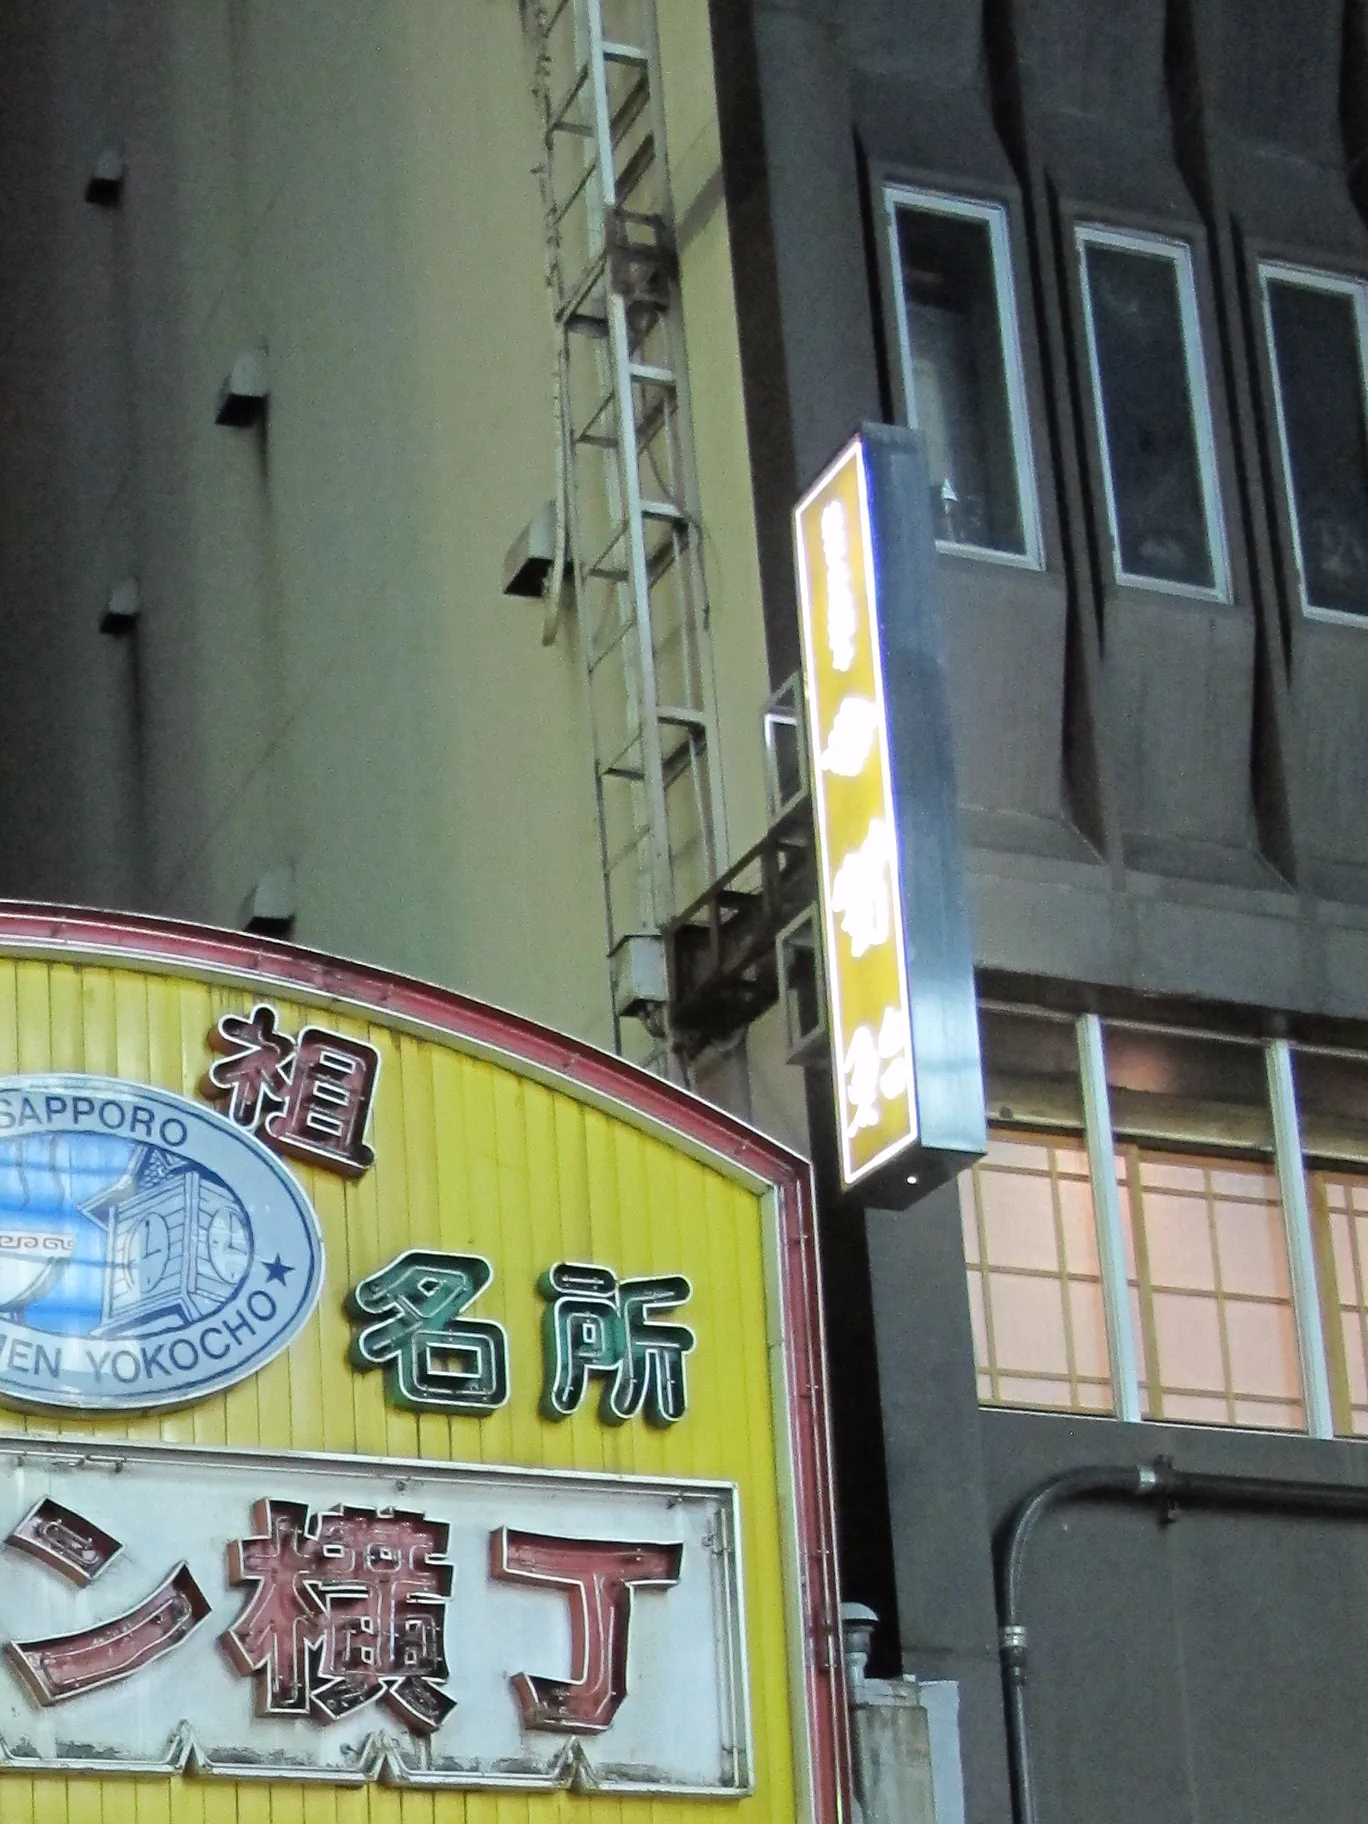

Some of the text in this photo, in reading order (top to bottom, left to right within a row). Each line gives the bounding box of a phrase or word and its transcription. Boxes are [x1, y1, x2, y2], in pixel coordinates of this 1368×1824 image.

[202, 1006, 380, 1176] 祖
[87, 1290, 278, 1383] YOKOCHO
[351, 1249, 695, 1426] 名所
